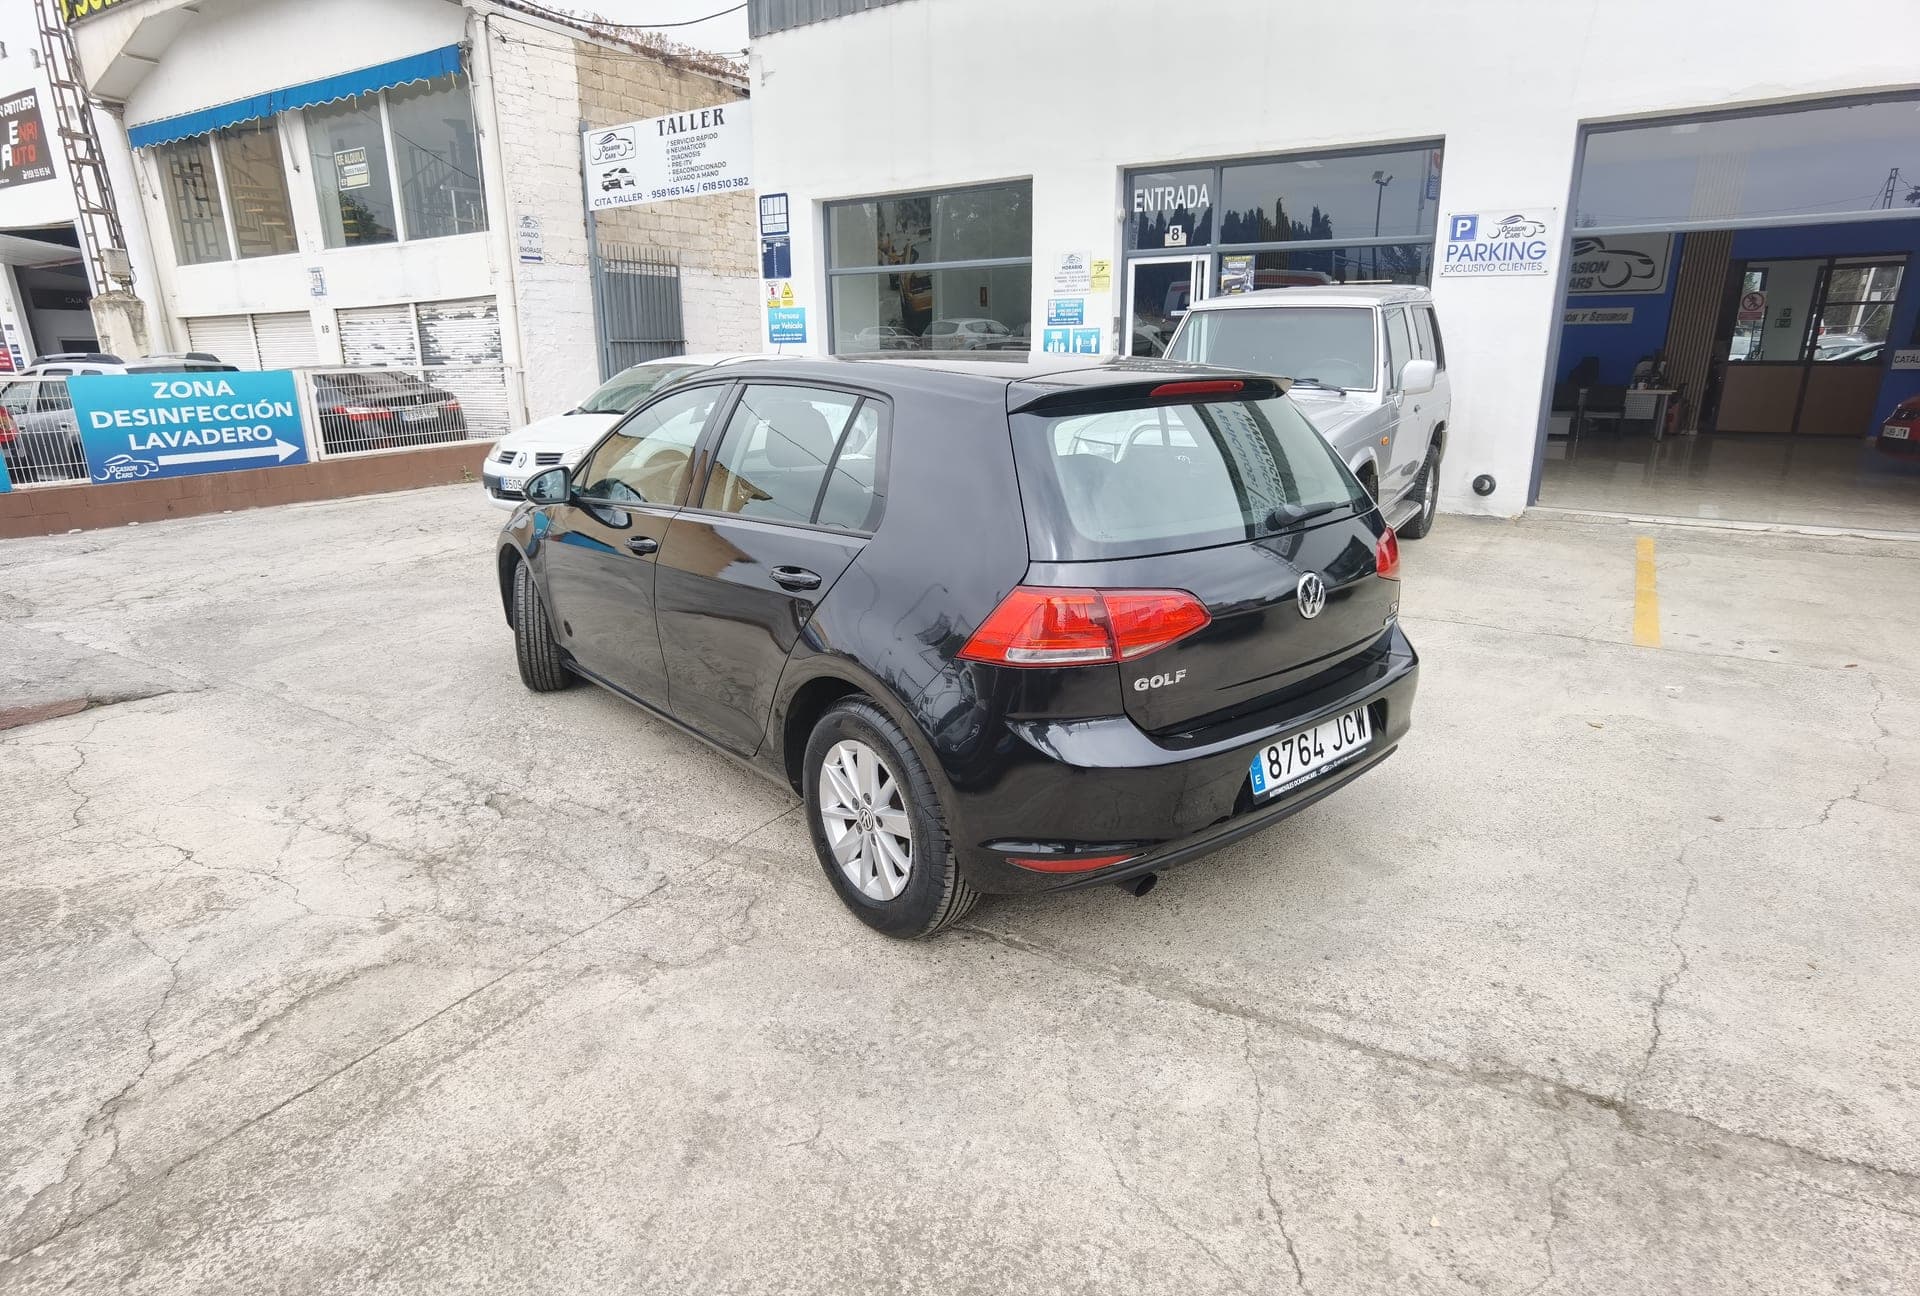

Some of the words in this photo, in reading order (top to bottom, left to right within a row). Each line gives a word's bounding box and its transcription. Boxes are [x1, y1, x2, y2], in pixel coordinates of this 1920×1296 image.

[657, 108, 725, 136] TALLER
[670, 137, 695, 146] SERVICIO
[2, 144, 37, 171] AUTO
[671, 150, 701, 161] DIAGNOSIS
[672, 161, 727, 175] REACONDICIONADO
[673, 173, 696, 182] LAVADO
[701, 170, 719, 178] MANO
[595, 198, 612, 207] CITA
[613, 192, 643, 203] TALLER
[1134, 184, 1210, 212] ENTRADA
[1171, 227, 1180, 241] 8
[1456, 220, 1472, 238] P
[1501, 225, 1527, 233] OCASION
[1504, 231, 1521, 239] CARS
[1446, 241, 1547, 262] PARKING
[1444, 263, 1496, 273] EXCLUSIVO
[1498, 262, 1543, 272] CLIENTES
[1571, 260, 1610, 274] ASION
[1569, 277, 1594, 289] ARS
[151, 380, 236, 399] ZONA
[90, 399, 294, 429] DESINFECCIÓN
[128, 425, 273, 451] LAVADERO
[110, 465, 138, 473] OCASION
[1134, 669, 1187, 691] GOLF
[1255, 775, 1262, 785] E
[1267, 727, 1325, 780] 8764
[1333, 707, 1366, 751] JCW
